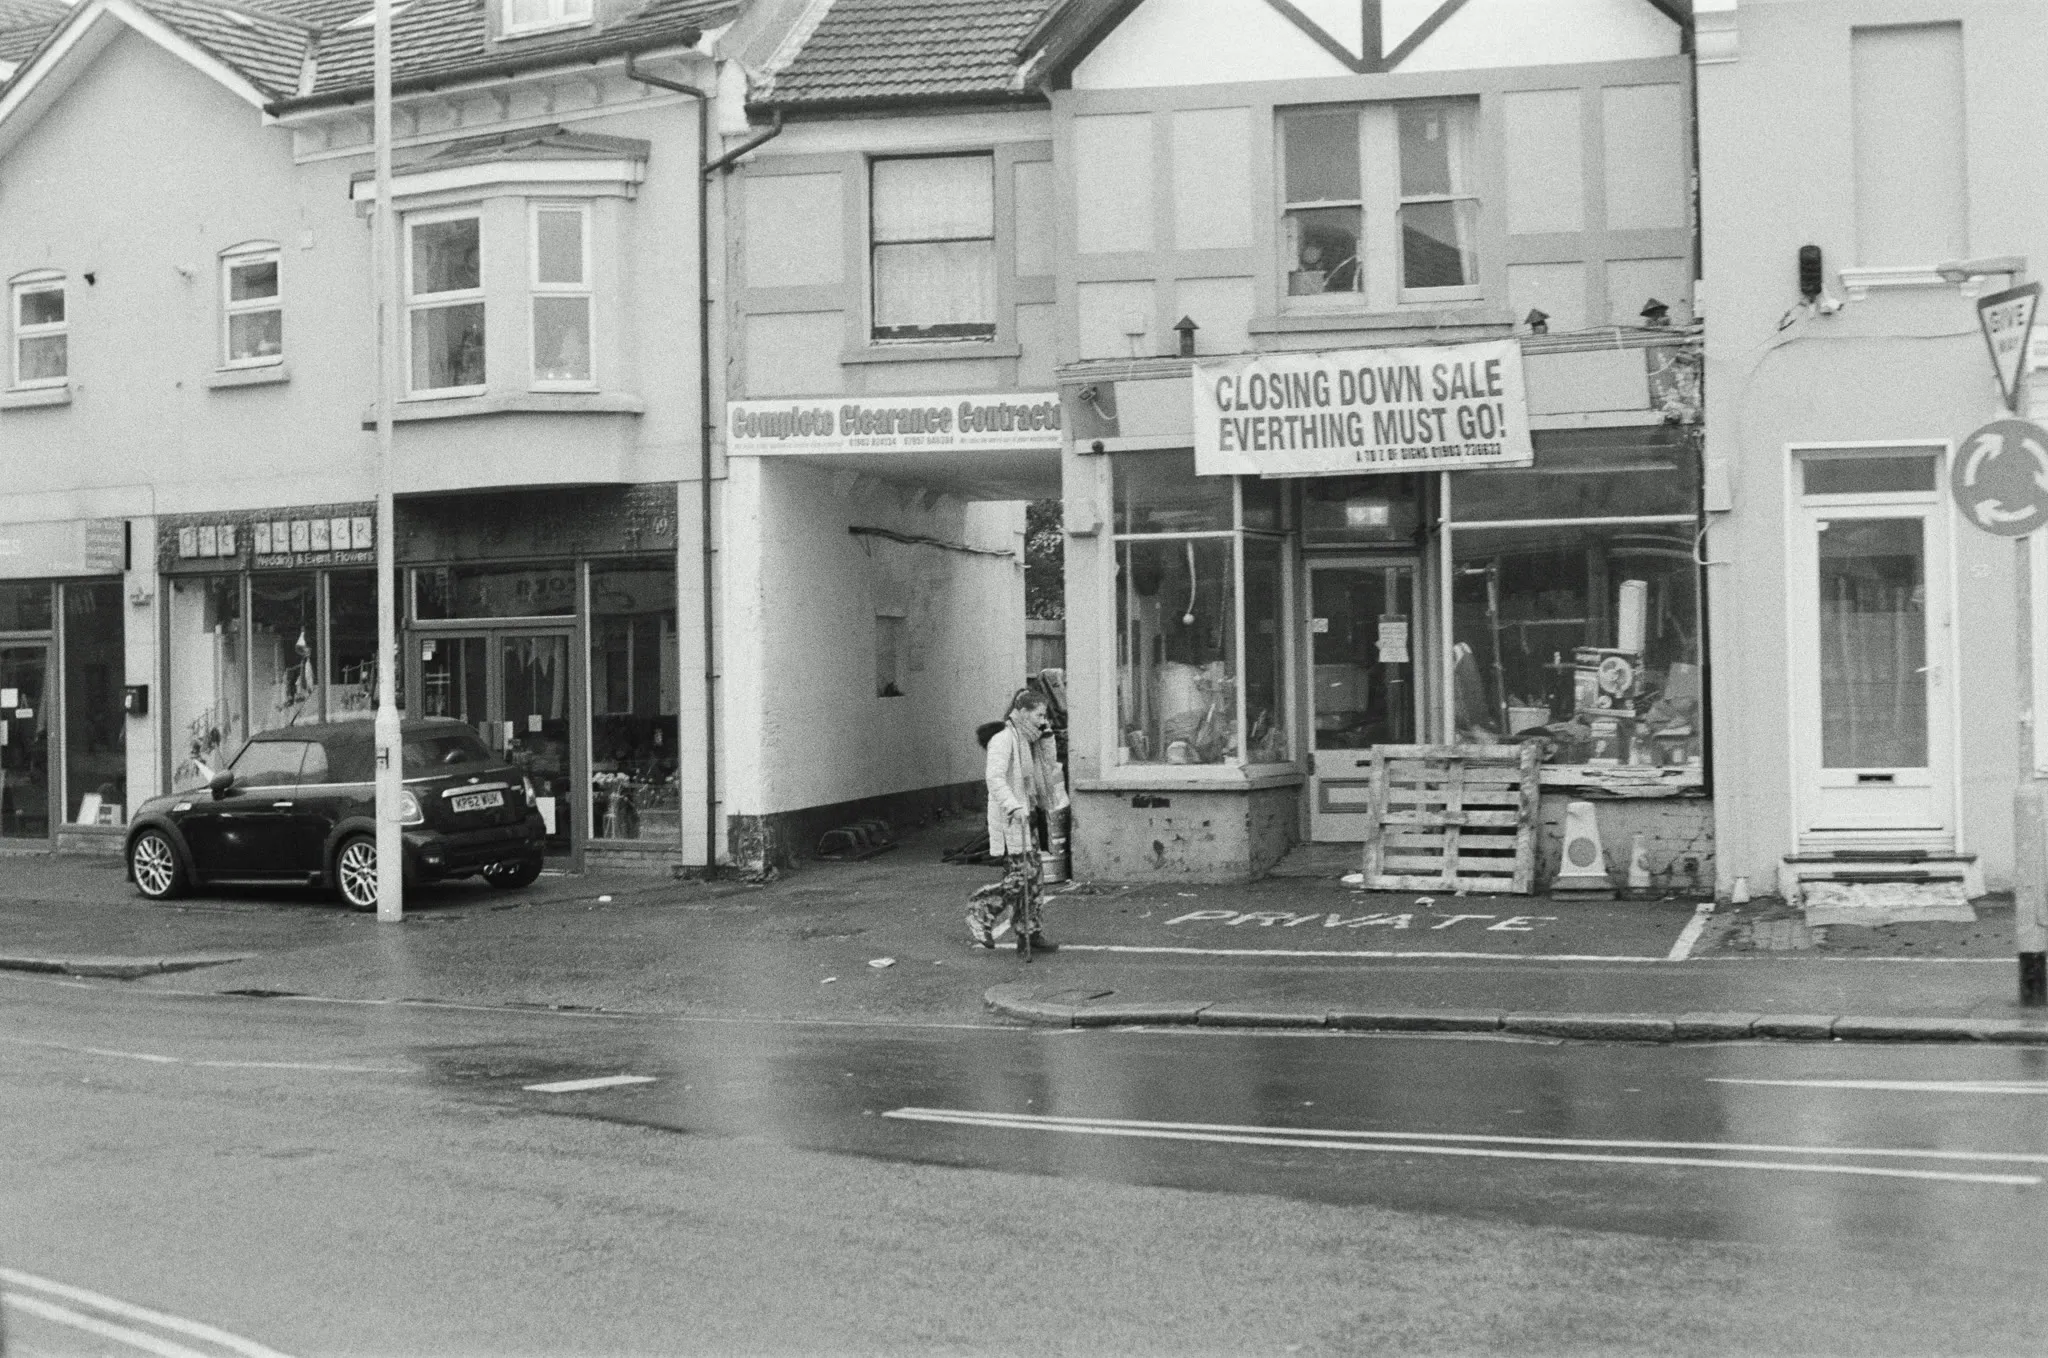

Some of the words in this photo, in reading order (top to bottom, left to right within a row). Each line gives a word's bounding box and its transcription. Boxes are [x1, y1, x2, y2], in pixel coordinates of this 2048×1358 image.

[1216, 369, 1331, 412] CLOSING
[1339, 366, 1423, 406] DOWN
[1431, 359, 1503, 401] SALE
[732, 406, 834, 440] Complete
[839, 404, 953, 436] Clearance
[1219, 412, 1364, 451] EVERTHING
[1373, 407, 1447, 445] MUST
[1457, 403, 1507, 440] GO!
[255, 554, 294, 568] Wedding
[307, 552, 331, 563] Event
[334, 551, 375, 562] Flowers
[1165, 909, 1558, 931] PRIVATE
